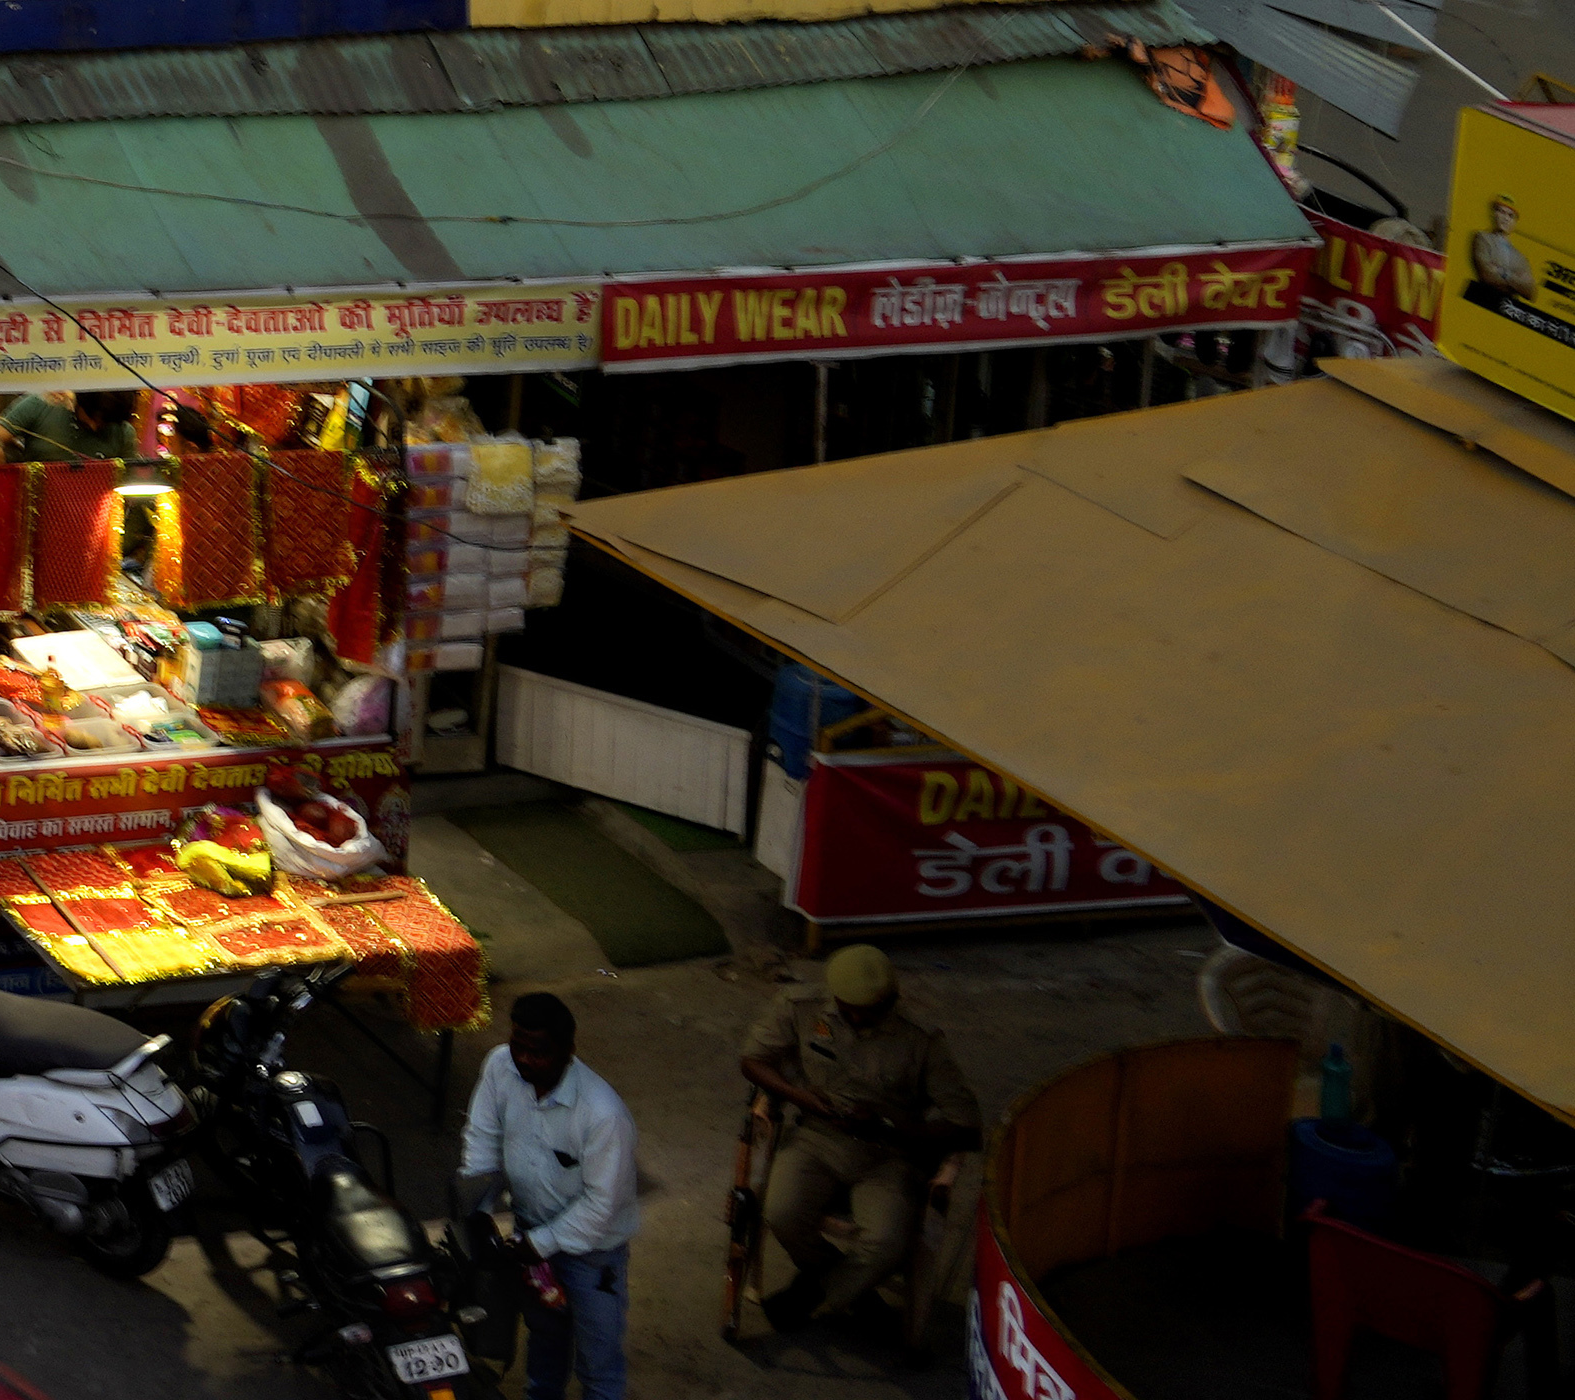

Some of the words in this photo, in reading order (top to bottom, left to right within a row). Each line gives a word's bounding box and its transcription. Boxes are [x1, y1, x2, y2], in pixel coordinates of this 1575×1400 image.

[613, 289, 728, 351] DAILY
[731, 284, 849, 344] WEAR
[1100, 261, 1190, 320] डेली
[42, 311, 69, 345] से
[335, 299, 377, 332] की
[917, 770, 1072, 827] DAIL
[910, 821, 1076, 899] डेली
